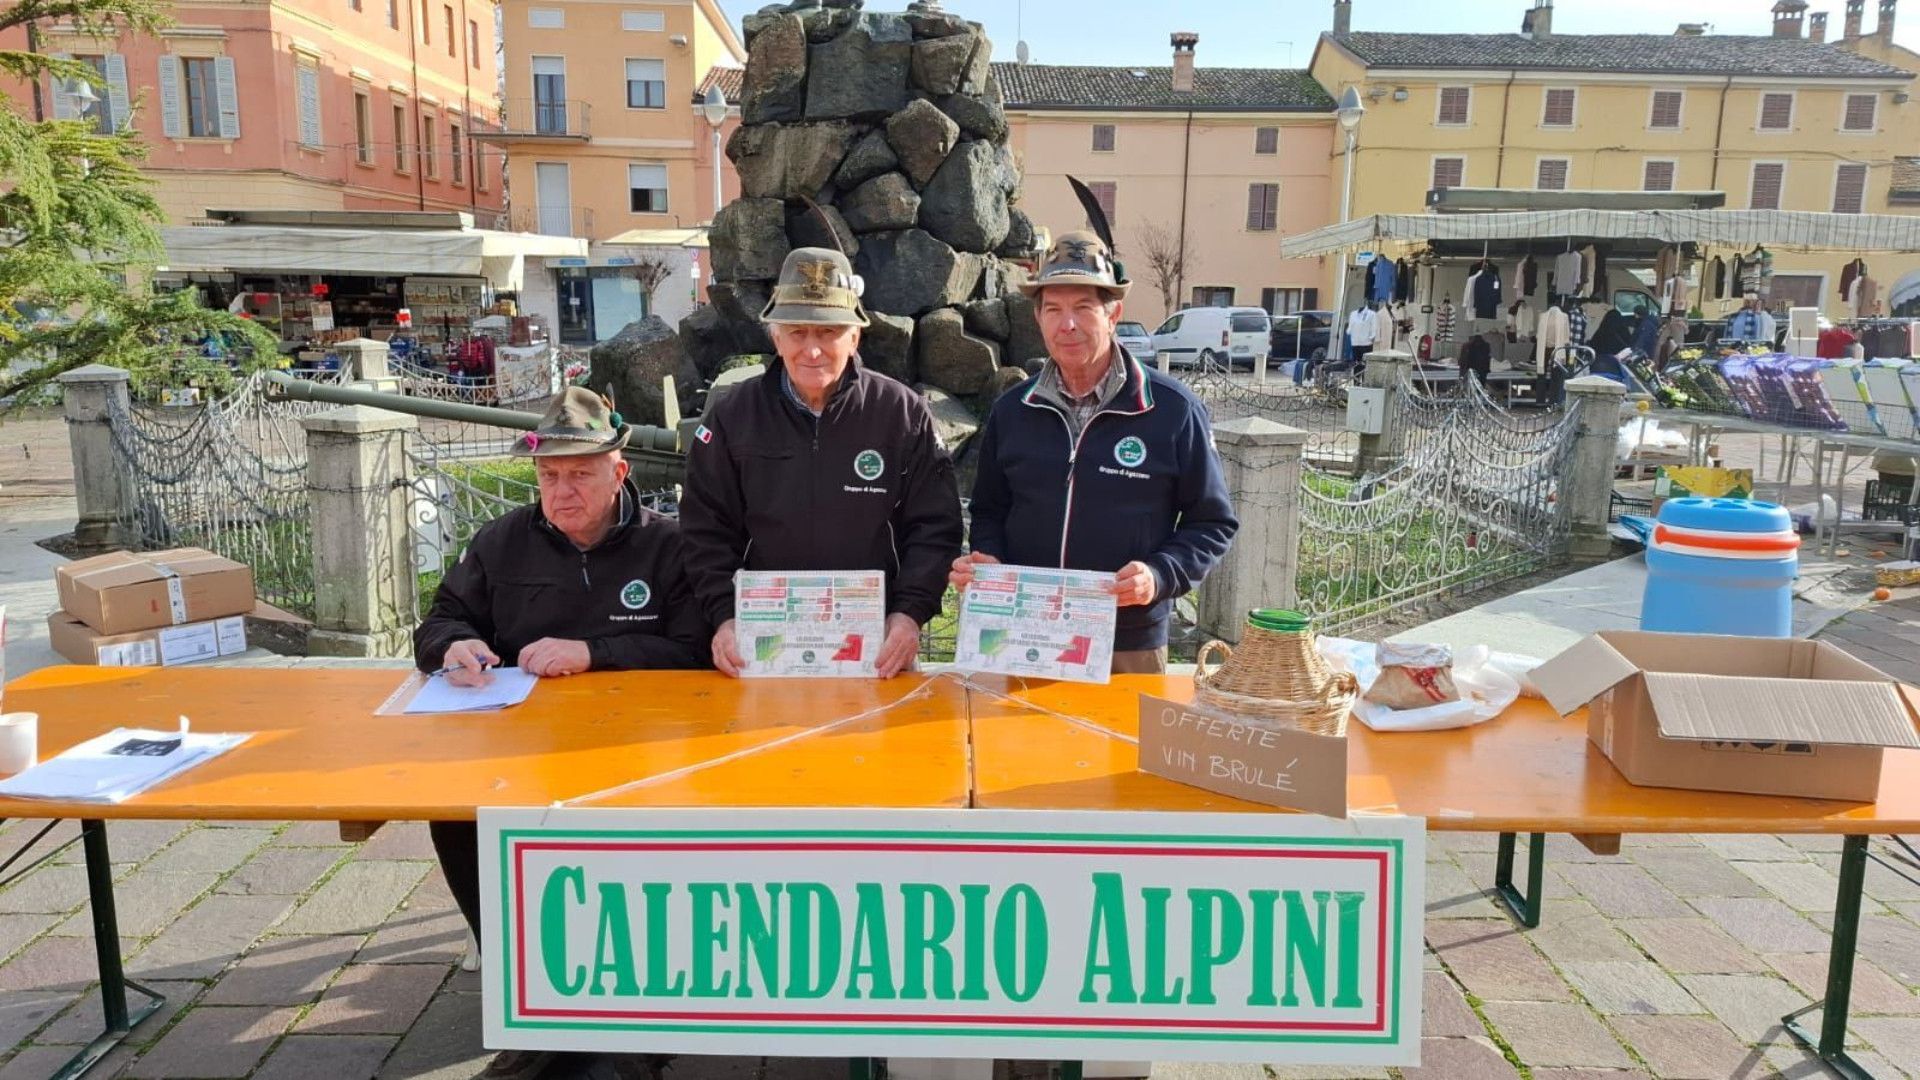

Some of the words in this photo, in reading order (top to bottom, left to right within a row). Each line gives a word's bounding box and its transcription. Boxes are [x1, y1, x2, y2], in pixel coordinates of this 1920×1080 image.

[1161, 707, 1281, 749] OFFERTE
[1162, 745, 1196, 772] VIN
[1208, 755, 1298, 793] BRULÉ
[540, 865, 1050, 1003] CALENDARIO
[1078, 871, 1366, 1008] ALPINI
